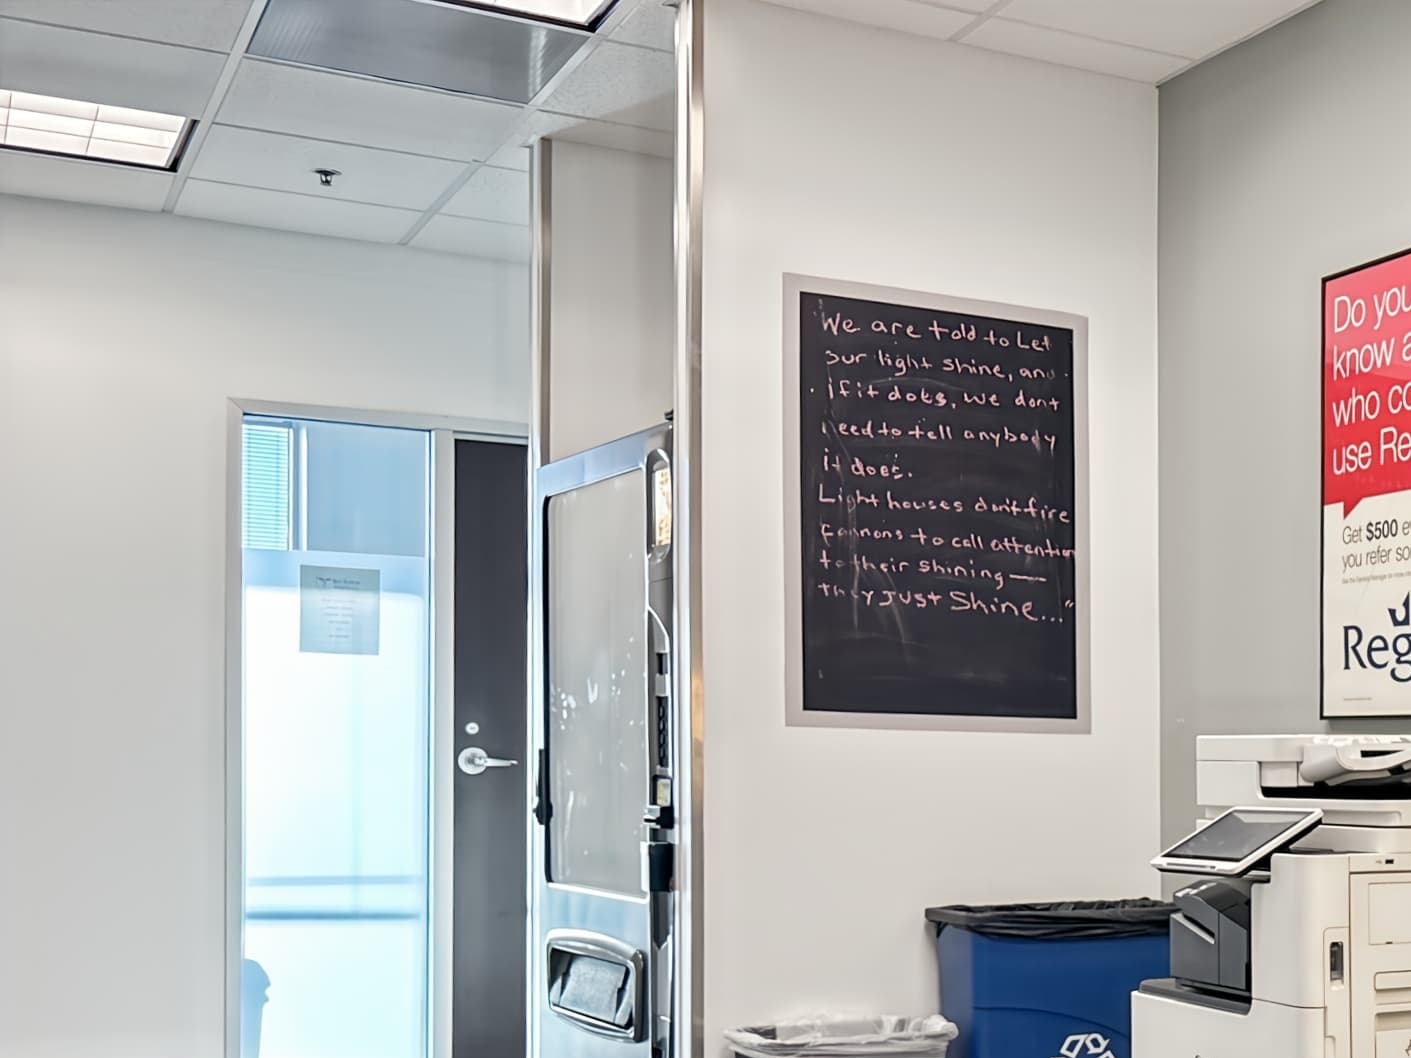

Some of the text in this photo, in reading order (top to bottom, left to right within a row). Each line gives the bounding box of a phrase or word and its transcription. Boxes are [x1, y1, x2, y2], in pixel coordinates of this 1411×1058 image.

[821, 311, 861, 336] We
[871, 320, 921, 339] are
[928, 319, 976, 341] told
[983, 329, 1010, 347] to
[1334, 295, 1366, 334] Do
[877, 348, 932, 377] light
[1333, 337, 1395, 381] know
[963, 391, 1001, 407] we
[1332, 387, 1380, 428] who
[877, 421, 903, 437] to
[907, 423, 953, 440] tell
[963, 426, 1057, 455] anybody
[823, 447, 841, 472] it
[1333, 440, 1372, 476] use
[1024, 496, 1071, 523] fire
[911, 528, 945, 546] to
[951, 532, 984, 550] call
[990, 536, 1077, 558] attention
[1342, 525, 1363, 544] Get
[1366, 519, 1398, 542] $500
[820, 549, 845, 570] to
[1342, 552, 1363, 574] you
[1365, 545, 1392, 566] refer
